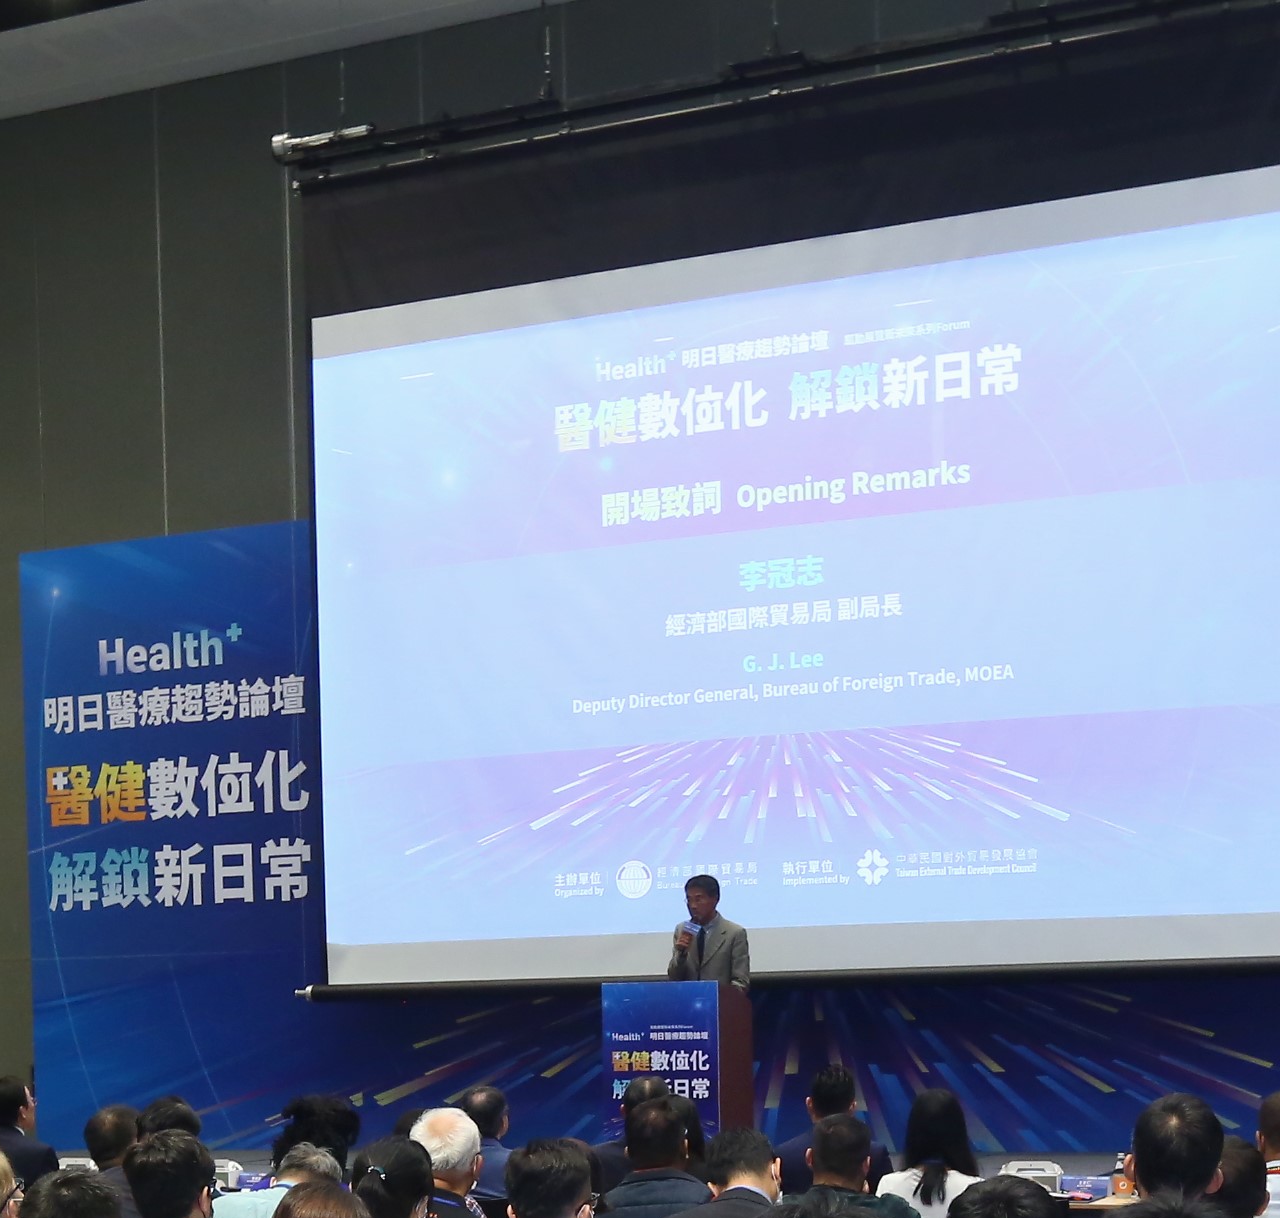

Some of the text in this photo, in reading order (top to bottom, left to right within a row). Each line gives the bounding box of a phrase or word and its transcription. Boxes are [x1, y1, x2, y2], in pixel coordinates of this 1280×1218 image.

[554, 343, 1021, 453] 醫健數位化 解鎖新日常
[601, 460, 971, 527] 開場致詞 Opening Remarks
[738, 554, 825, 592] 李冠志
[664, 593, 903, 637] 經濟部國際貿易局 副局長
[572, 664, 1015, 716] Deputy Director General, Bureau of Foreign Trade, MOEA
[742, 651, 824, 673] G. J. Lee
[43, 674, 306, 734] 明日醫療趨勢論壇
[45, 750, 310, 827] 醫健數位化
[48, 838, 312, 912] 解鎖新日常
[612, 1078, 710, 1100] 解日常
